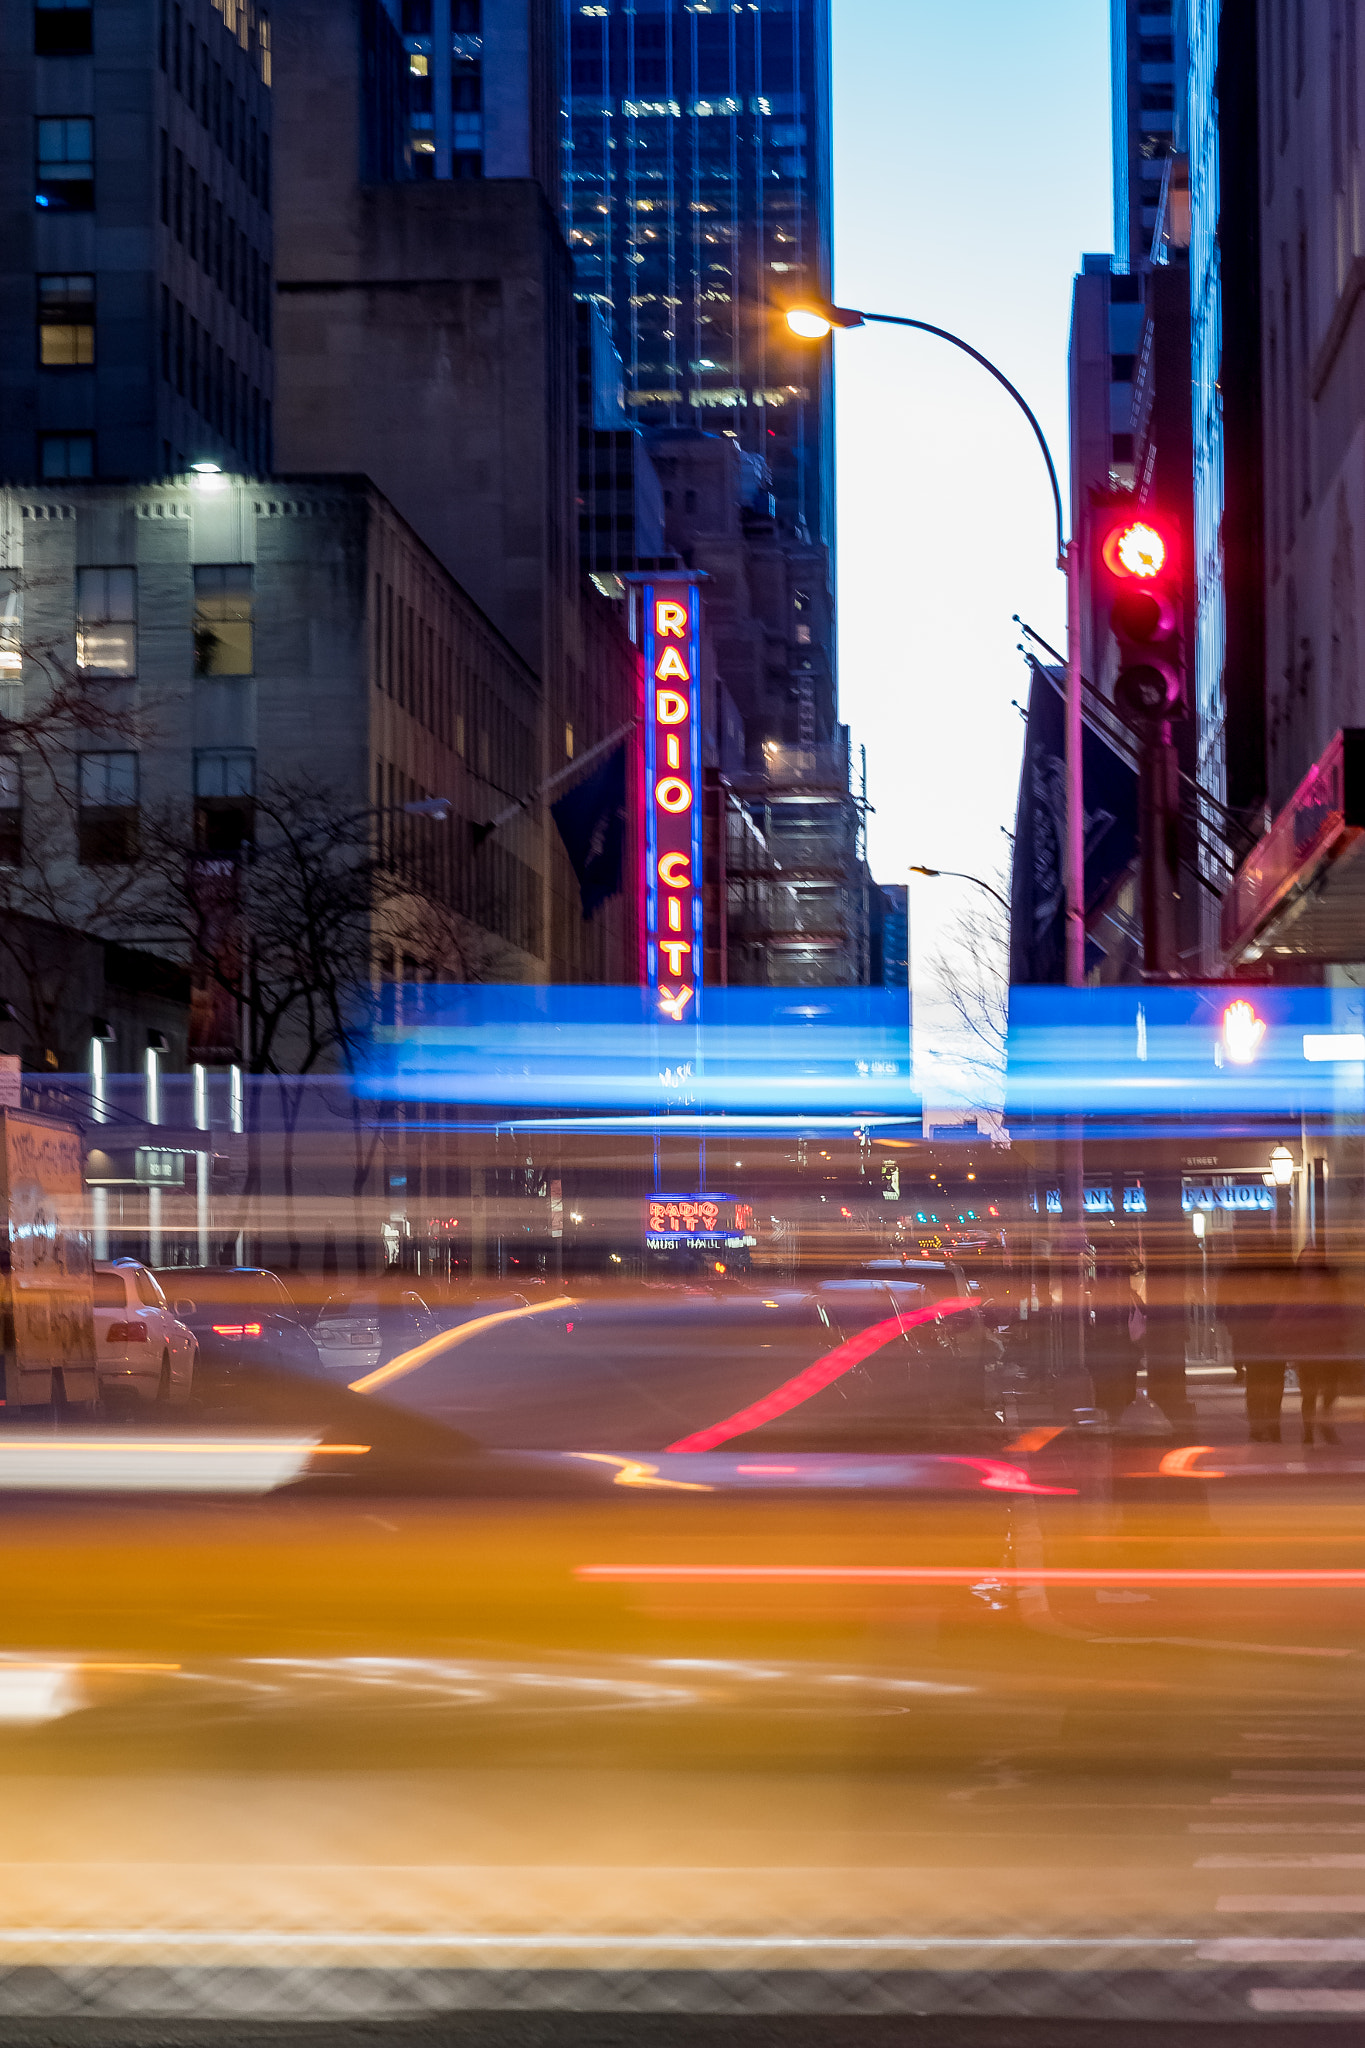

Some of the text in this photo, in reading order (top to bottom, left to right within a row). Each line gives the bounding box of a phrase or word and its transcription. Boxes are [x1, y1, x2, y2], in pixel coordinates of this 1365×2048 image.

[654, 600, 694, 1021] RADIO CITY
[658, 1060, 695, 1088] MUSIC
[1187, 1156, 1218, 1166] STREET
[649, 1201, 719, 1217] RADIO
[649, 1217, 718, 1232] CITY
